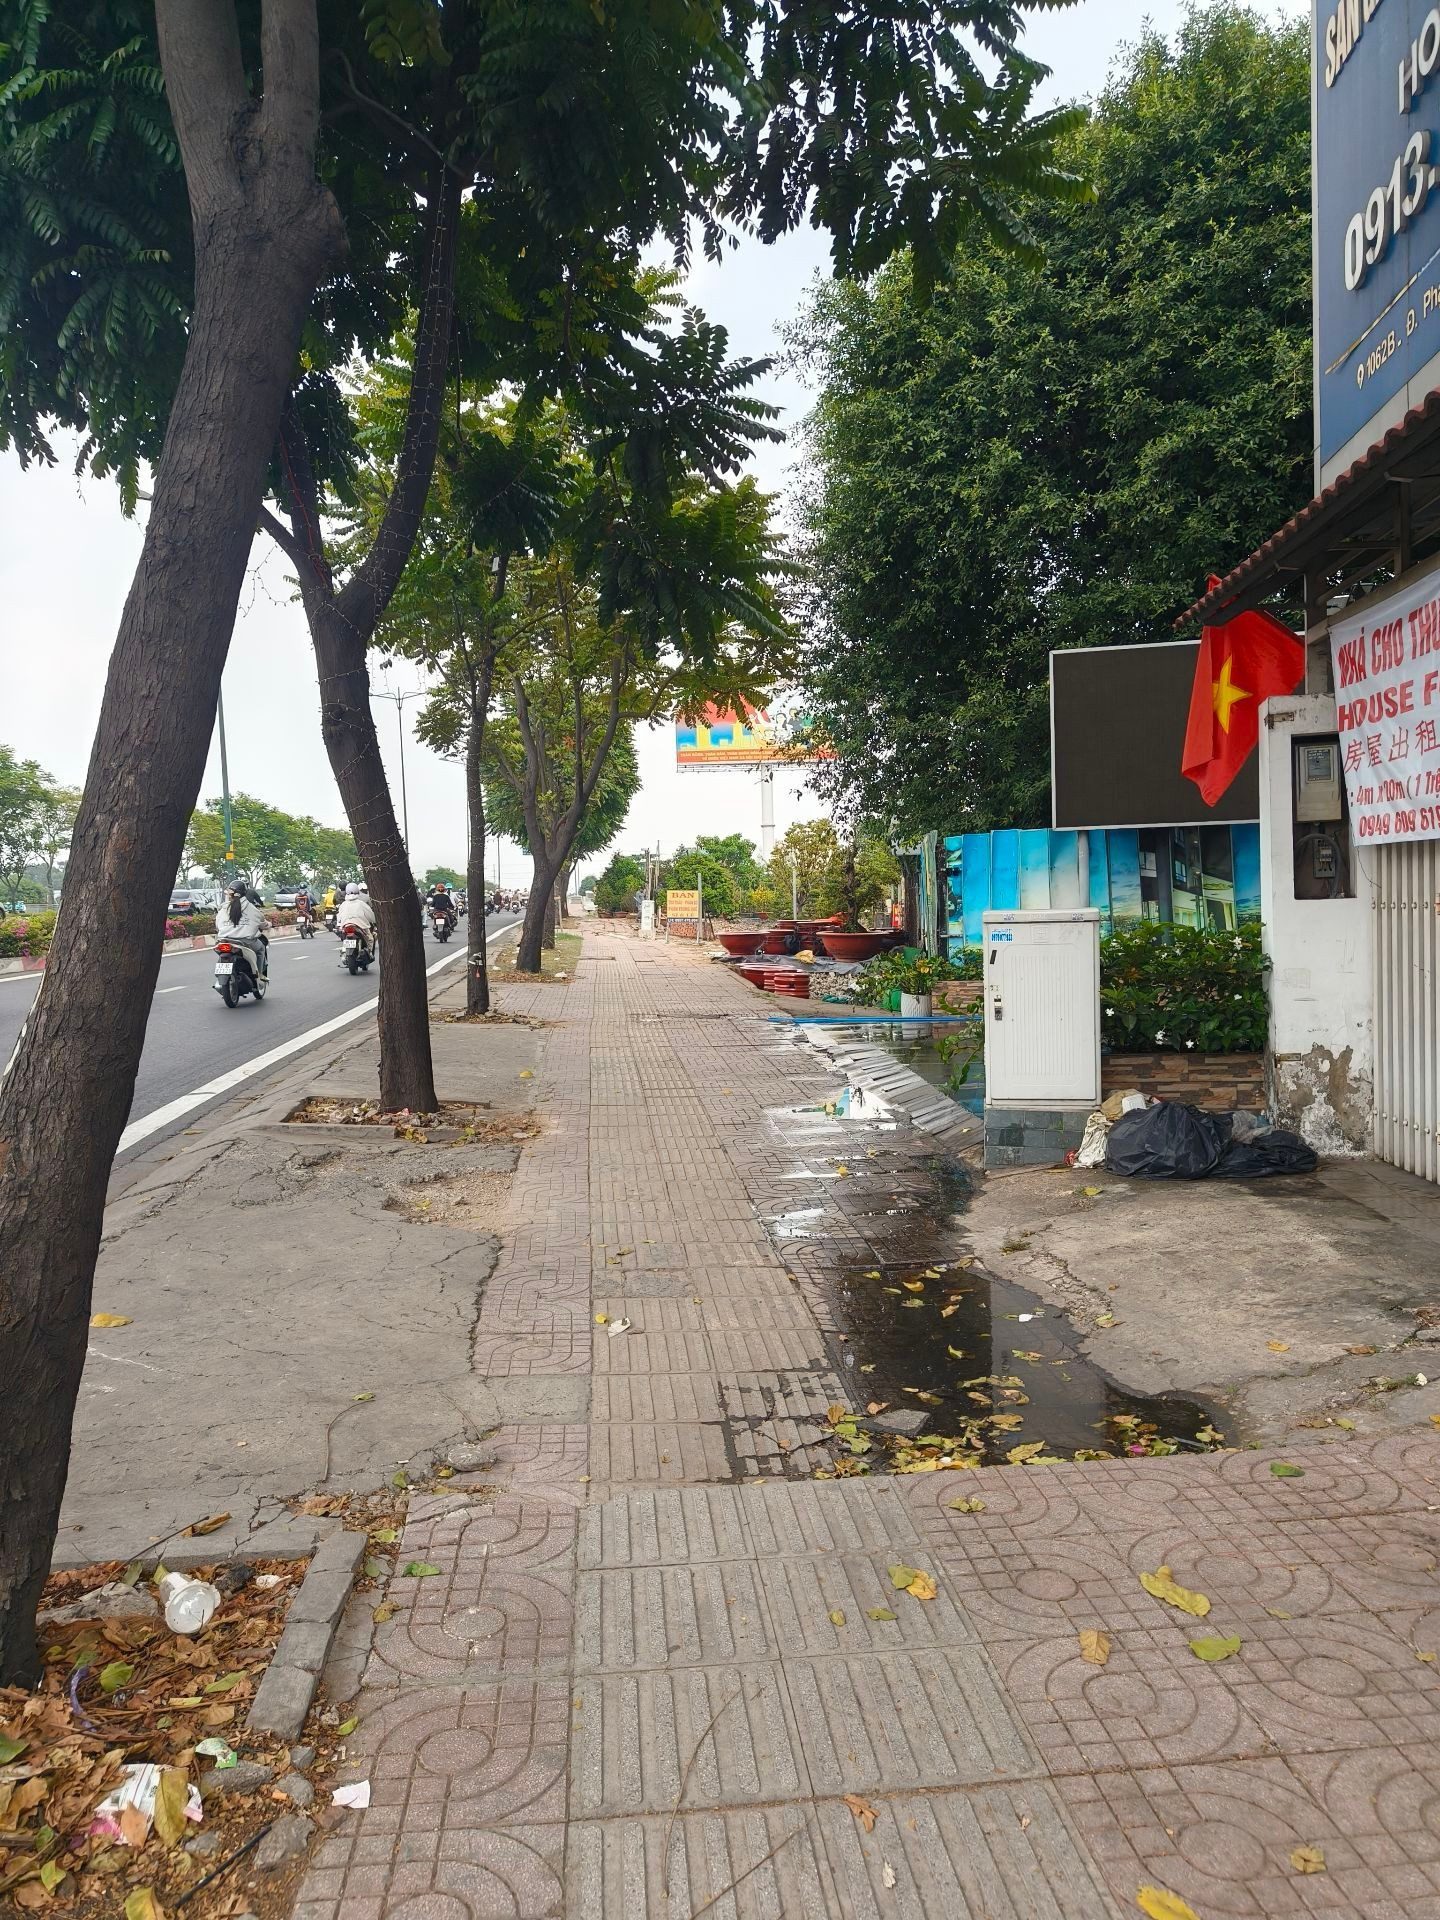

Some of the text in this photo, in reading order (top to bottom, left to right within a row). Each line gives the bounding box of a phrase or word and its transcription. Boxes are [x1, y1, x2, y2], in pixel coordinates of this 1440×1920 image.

[1371, 617, 1404, 676] CHO
[1338, 679, 1414, 733] HOUSE
[1344, 719, 1440, 774] 房屋出租
[1360, 813, 1391, 838] 0949
